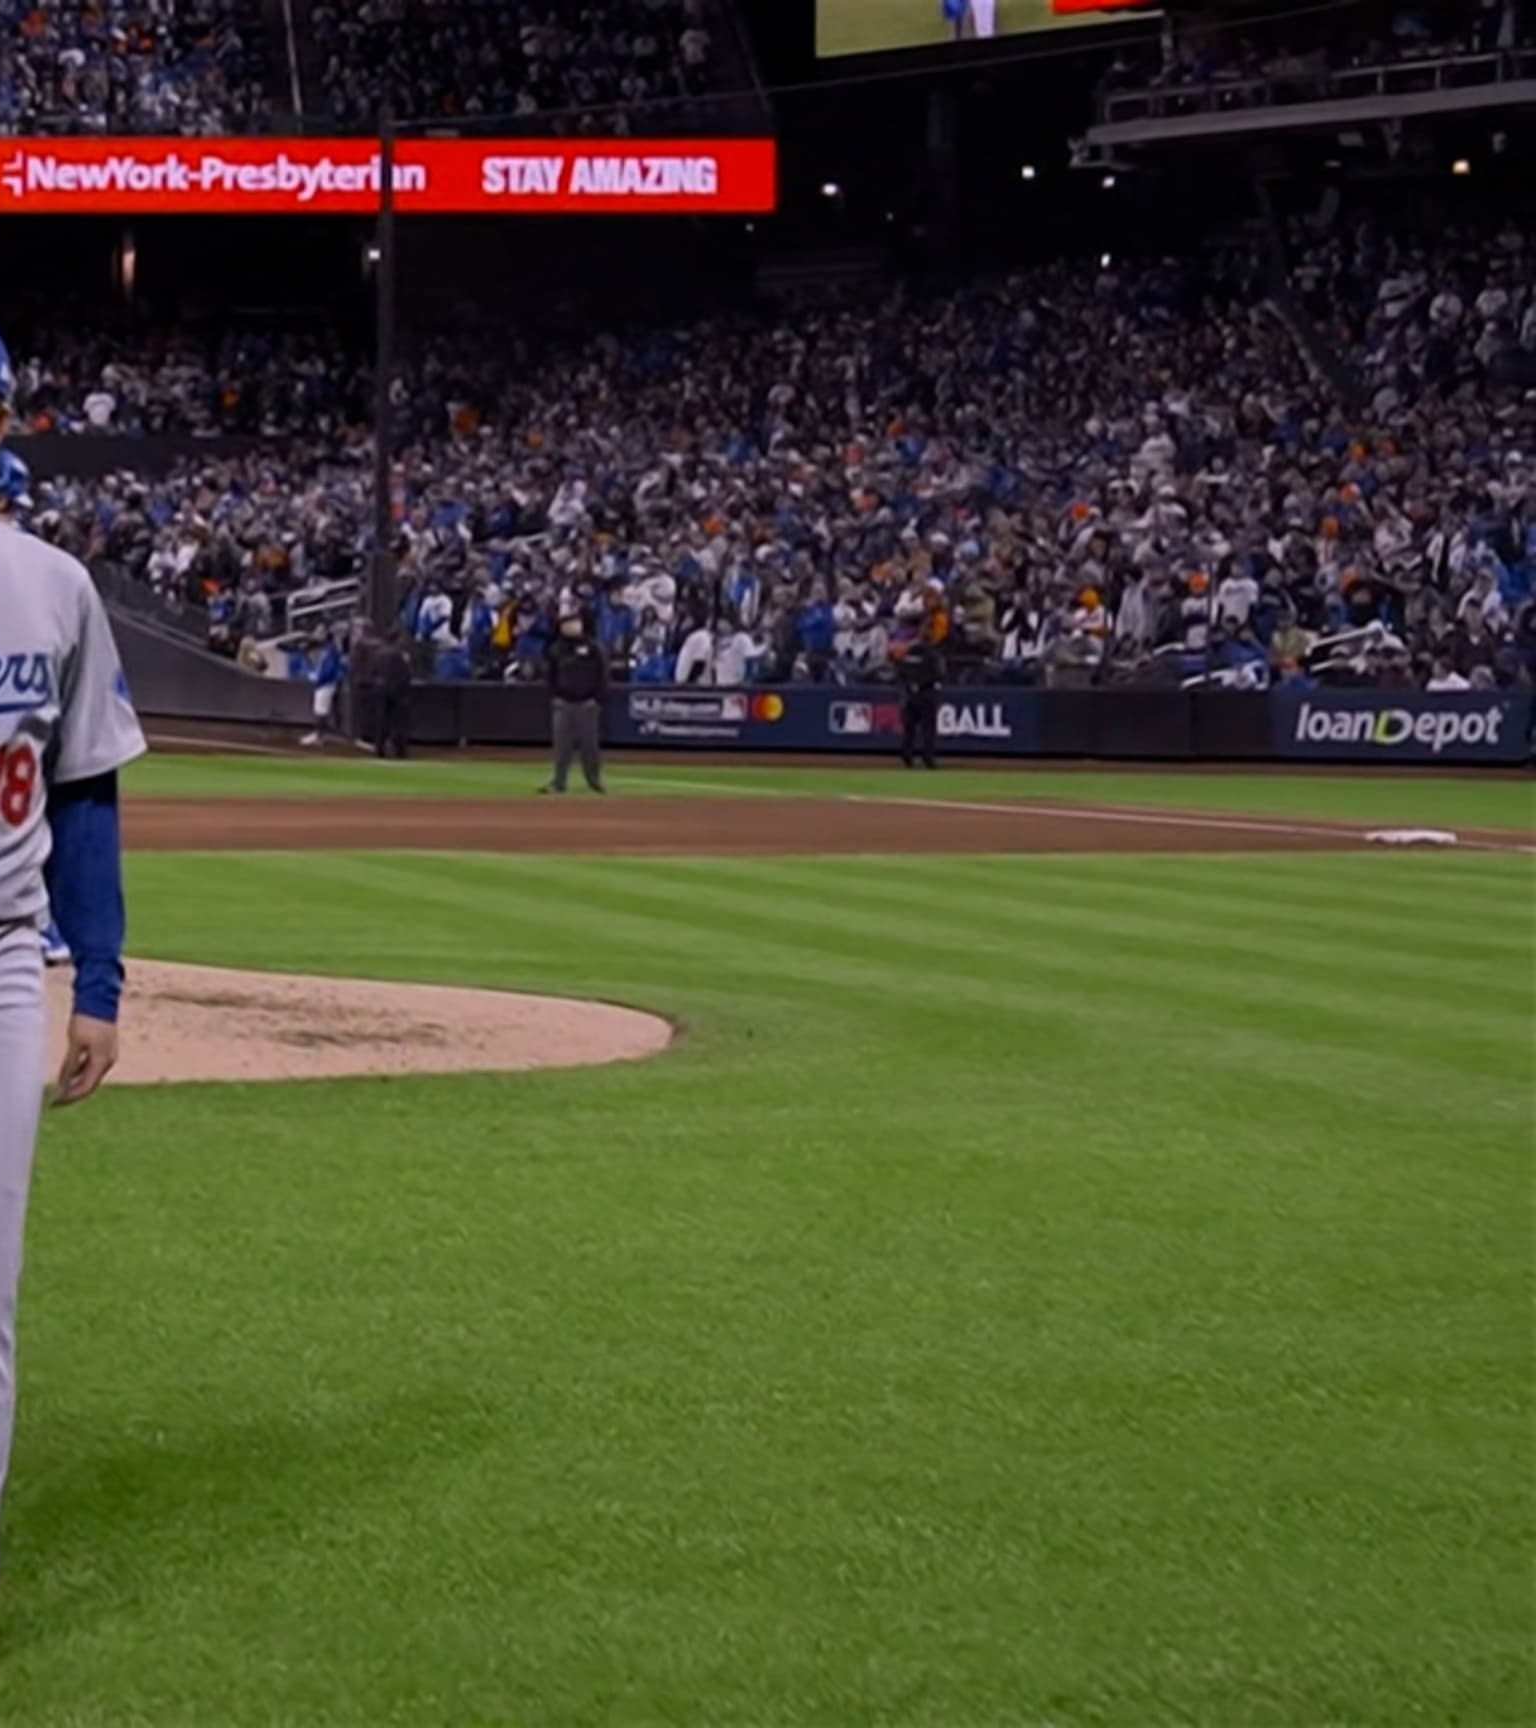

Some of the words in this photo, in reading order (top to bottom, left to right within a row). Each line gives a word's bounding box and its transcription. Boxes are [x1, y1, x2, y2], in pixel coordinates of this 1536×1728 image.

[483, 157, 563, 193] STAY
[570, 157, 716, 194] AMAZING
[937, 703, 1012, 737] BALL
[1296, 703, 1503, 752] loanDepot
